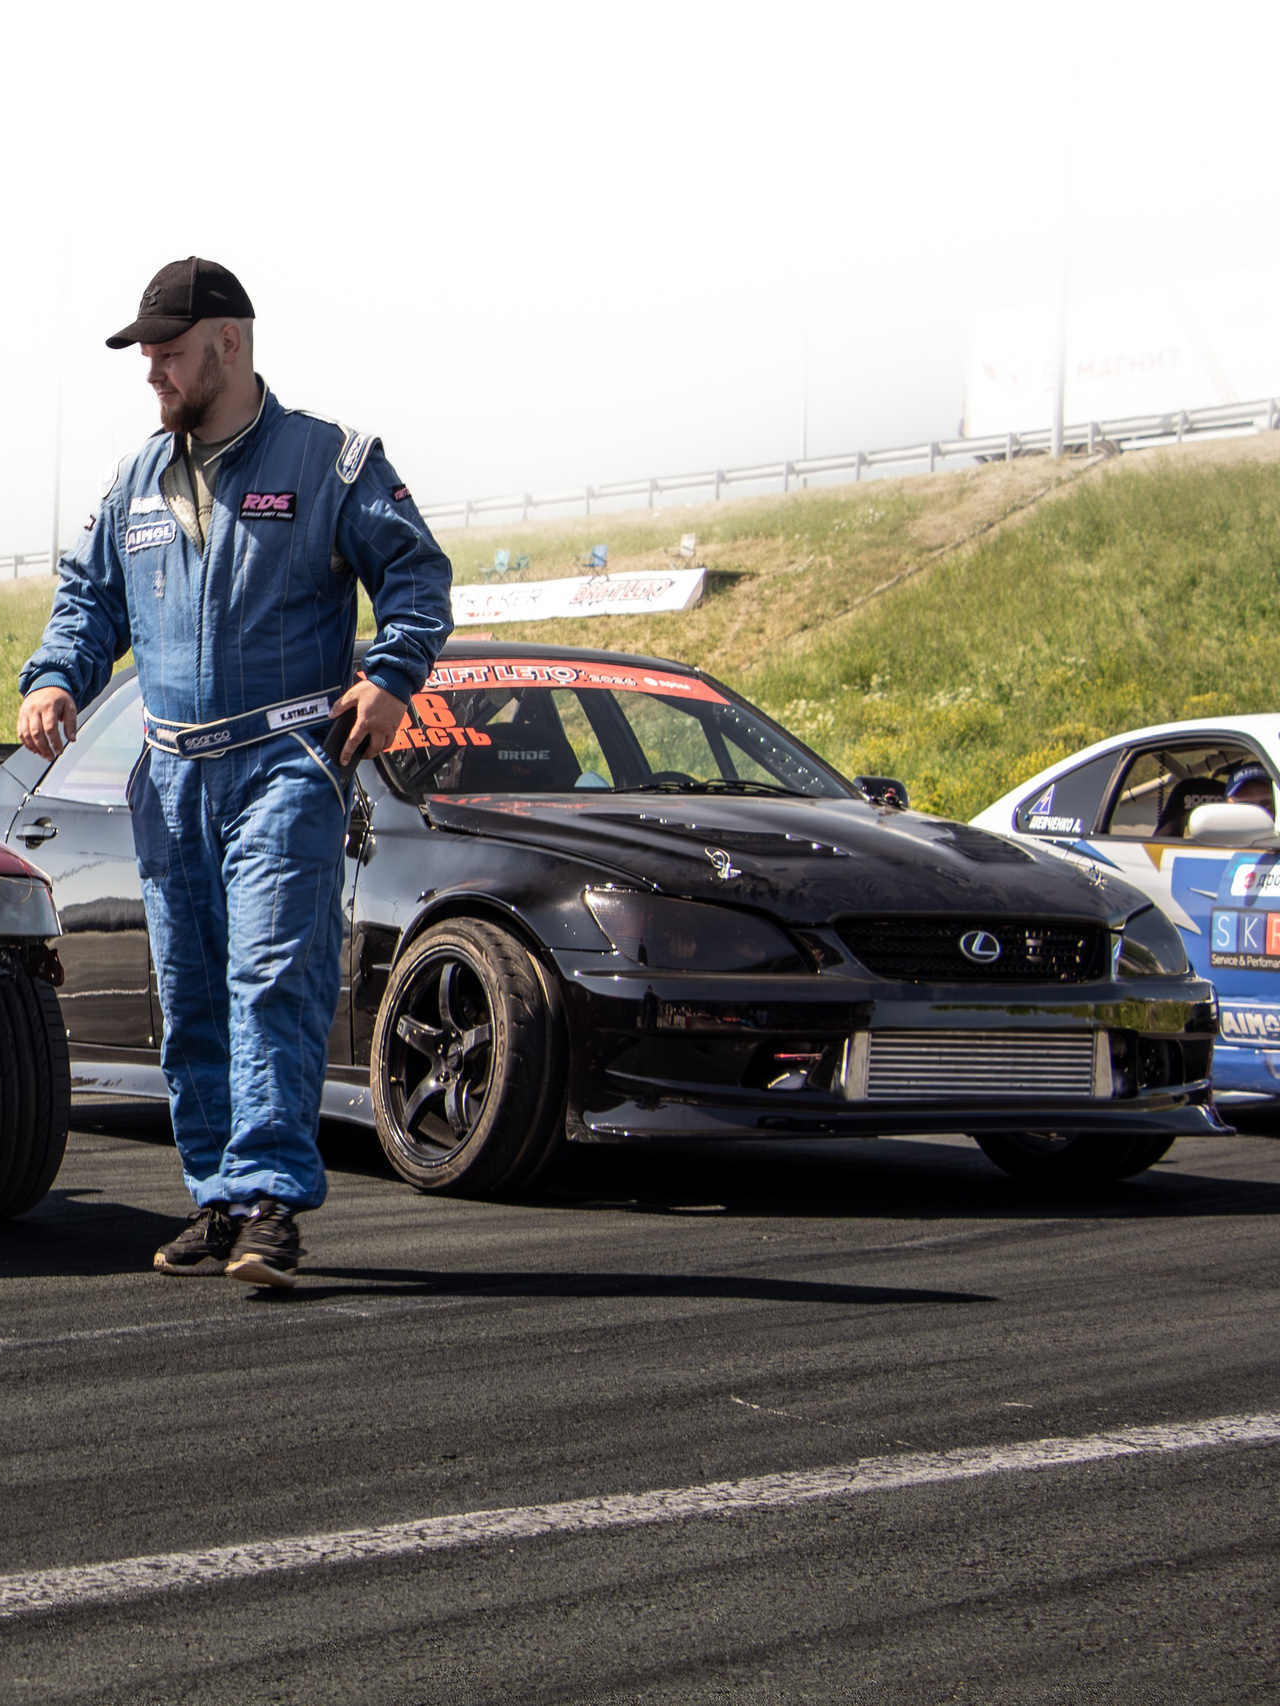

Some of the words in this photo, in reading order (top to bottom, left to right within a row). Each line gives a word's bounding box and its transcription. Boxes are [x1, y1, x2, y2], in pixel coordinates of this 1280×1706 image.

[242, 493, 294, 510] RDS
[572, 581, 626, 604] DRIFT
[620, 579, 671, 600] LETO
[426, 666, 489, 687] RIFT
[495, 665, 578, 684] LETO
[185, 730, 231, 749] sparco
[497, 750, 550, 760] BRIDE
[1029, 816, 1073, 831] ШЕВЧЕНКО
[1211, 953, 1238, 967] Service
[1238, 955, 1246, 967] &
